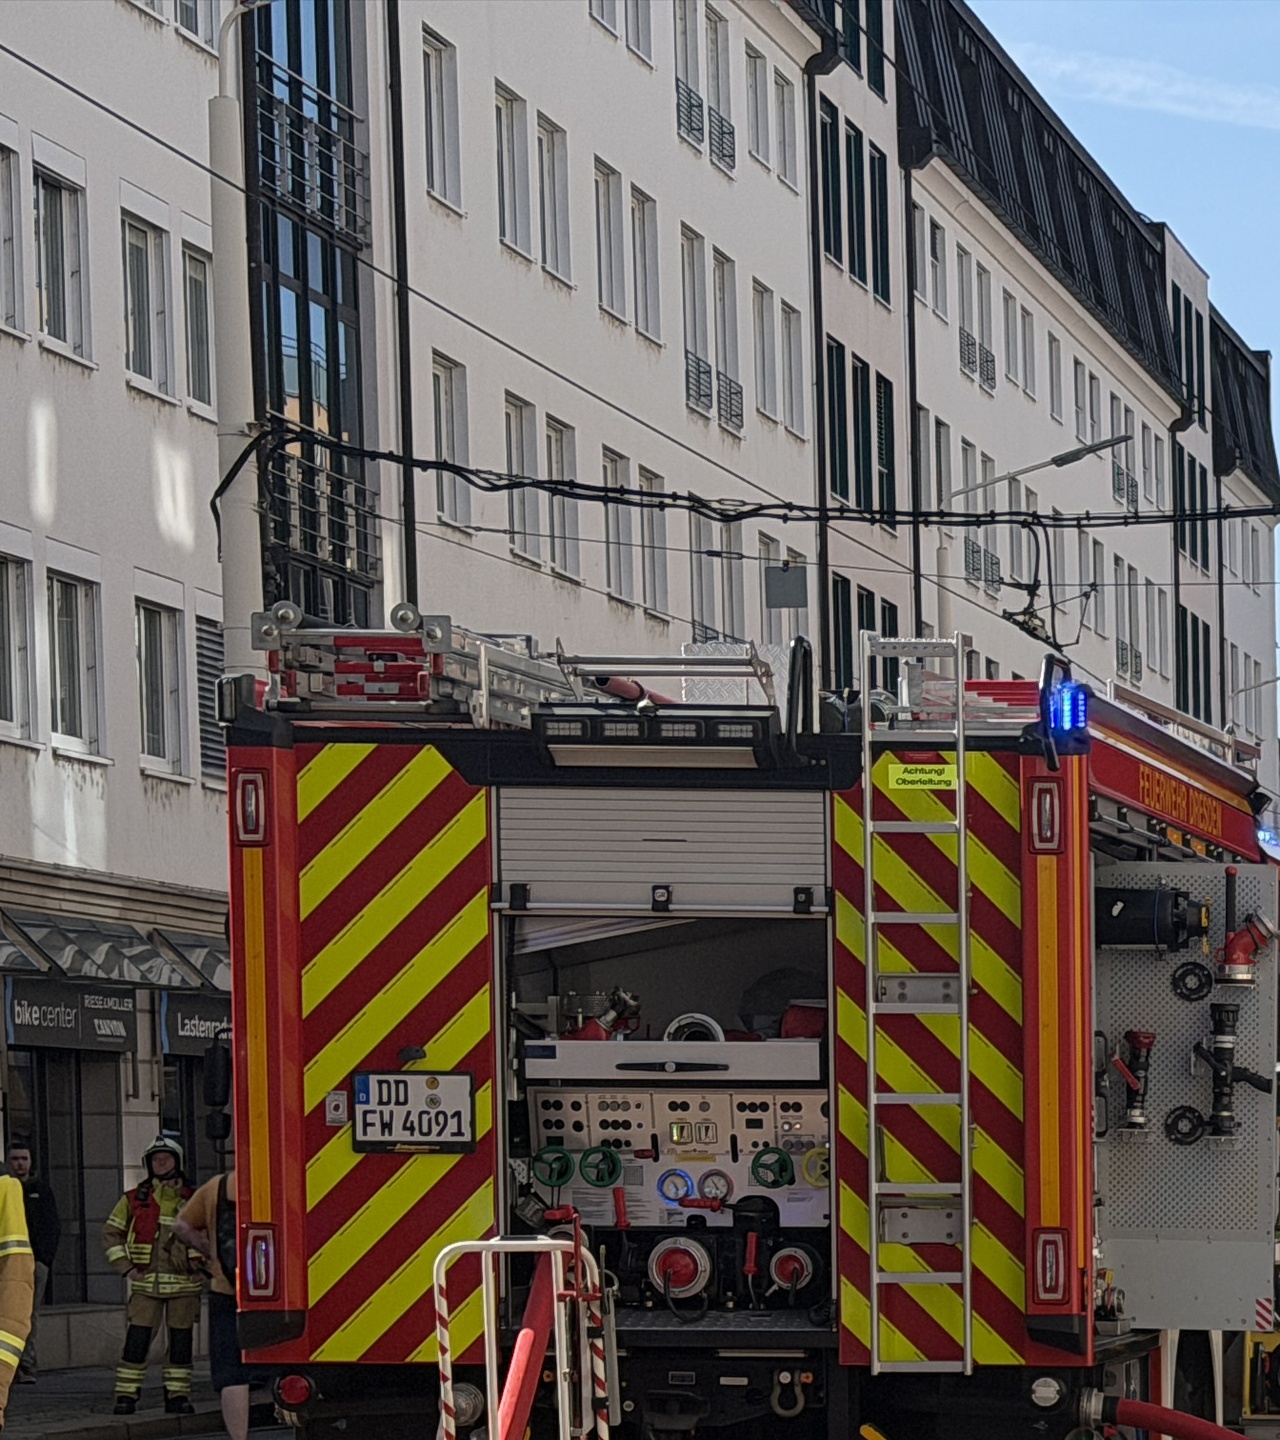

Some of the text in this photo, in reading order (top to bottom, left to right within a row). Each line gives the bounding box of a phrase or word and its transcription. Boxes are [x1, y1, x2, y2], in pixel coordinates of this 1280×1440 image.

[896, 777, 951, 787] Oberleitung
[902, 767, 945, 776] Achtung!
[1139, 763, 1222, 839] FEUERWEHR DRESDEN
[14, 1000, 77, 1029] bike center
[359, 1093, 367, 1102] D
[376, 1079, 409, 1106] DD
[362, 1109, 465, 1137] FW 4091
